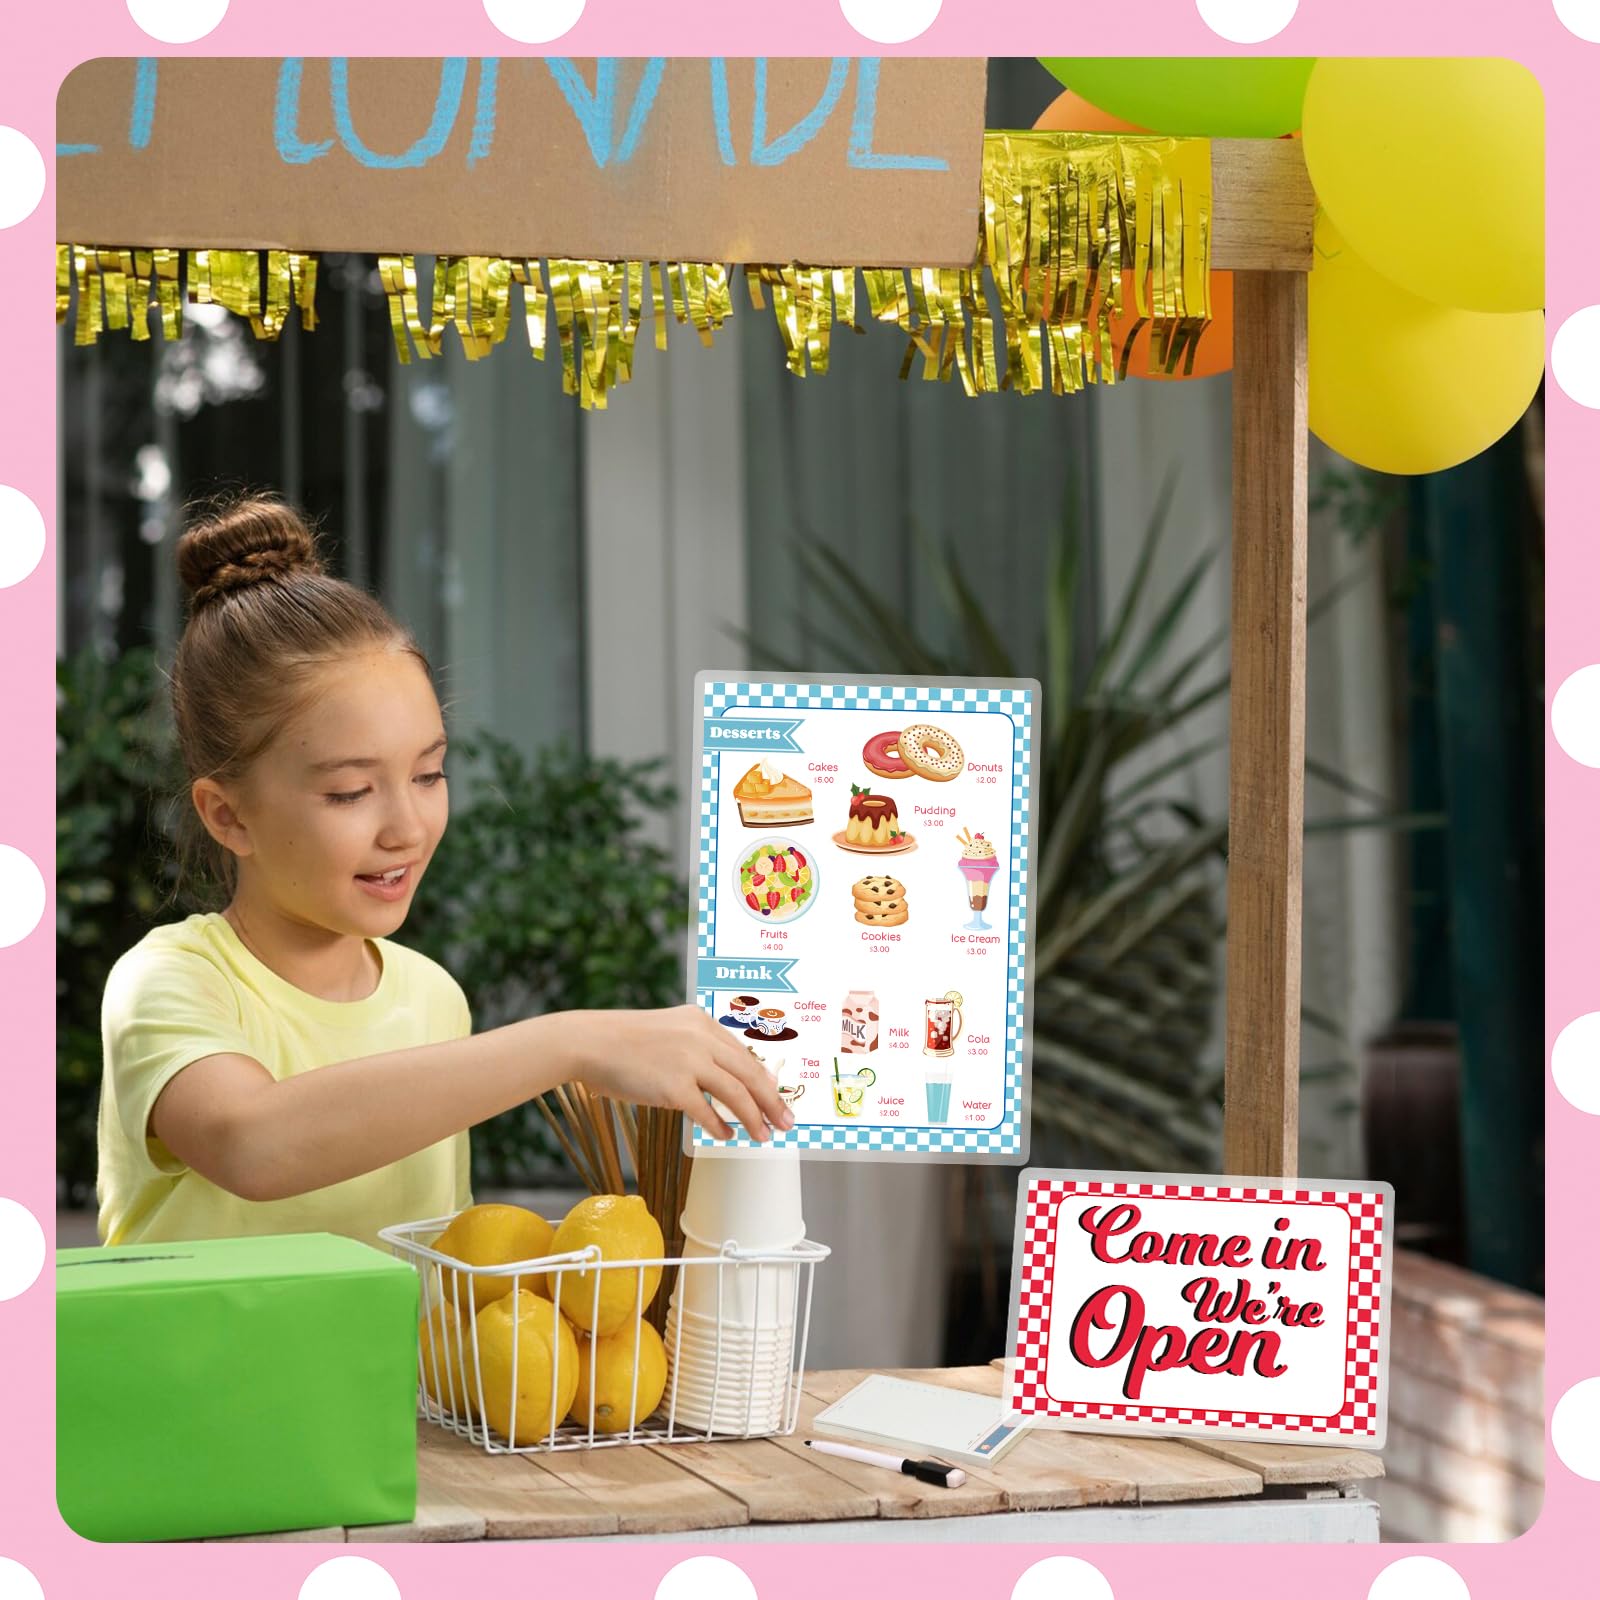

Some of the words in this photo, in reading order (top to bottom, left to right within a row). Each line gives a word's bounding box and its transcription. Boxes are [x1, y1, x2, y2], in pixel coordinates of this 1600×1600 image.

[709, 726, 782, 740] Desserts
[807, 762, 839, 773] Cakes
[967, 762, 1004, 773] Donuts
[975, 776, 997, 784] $2.00
[913, 805, 957, 818] Pudding
[923, 819, 944, 827] $3.00
[759, 929, 789, 940] Fruits
[860, 931, 902, 942] Cookies
[950, 934, 966, 944] Ice
[967, 934, 1001, 945] Cream
[762, 943, 784, 951] $4.00
[869, 945, 890, 953] $3.00
[966, 947, 987, 955] $3.00
[715, 964, 773, 980] Drink
[793, 1000, 828, 1010] Coffee
[800, 1014, 822, 1022] $2.00
[841, 1018, 866, 1040] MILK
[888, 1027, 910, 1037] Milk
[967, 1034, 991, 1044] Cola
[888, 1041, 910, 1049] $4.00
[967, 1048, 988, 1056] $3.00
[801, 1057, 820, 1067] Tea
[799, 1071, 820, 1079] $2.00
[877, 1096, 905, 1106] Juice
[962, 1100, 992, 1110] Water
[879, 1109, 900, 1117] $2.00
[964, 1114, 986, 1122] $1.00
[1078, 1203, 1253, 1268] Come
[1261, 1217, 1327, 1272] in
[1181, 1277, 1326, 1328] We're
[1068, 1284, 1288, 1401] Open
